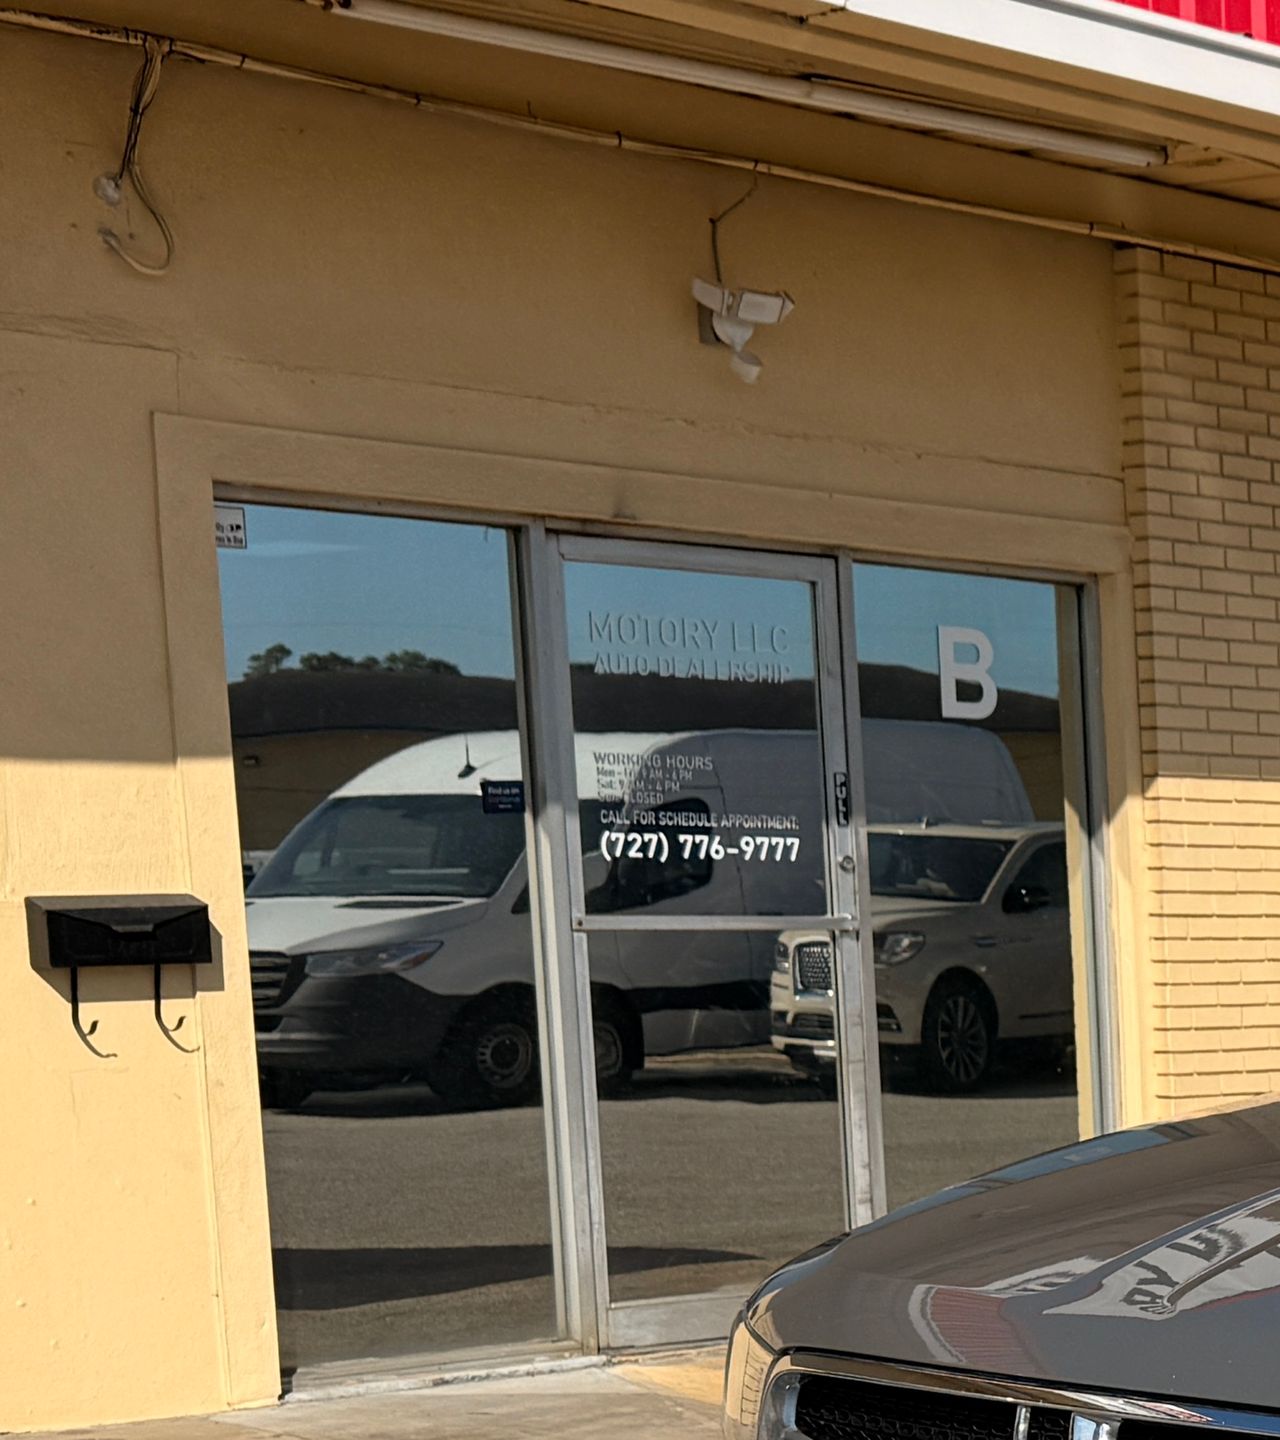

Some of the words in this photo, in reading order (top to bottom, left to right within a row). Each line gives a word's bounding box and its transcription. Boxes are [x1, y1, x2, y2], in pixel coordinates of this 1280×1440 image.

[588, 610, 718, 651] MOTORY
[731, 621, 789, 655] LLC
[593, 651, 650, 677] AUTO
[938, 625, 998, 721] B
[593, 752, 661, 769] WORKING
[666, 755, 713, 771] HOURS
[664, 780, 680, 792] PM
[679, 769, 693, 782] PM
[625, 791, 664, 804] LOSED
[836, 773, 847, 825] PULL
[600, 809, 630, 825] CALL
[633, 810, 656, 826] FOR
[658, 811, 718, 828] SCHEDULE
[600, 830, 669, 863] (727)
[678, 833, 801, 862] 776-9777
